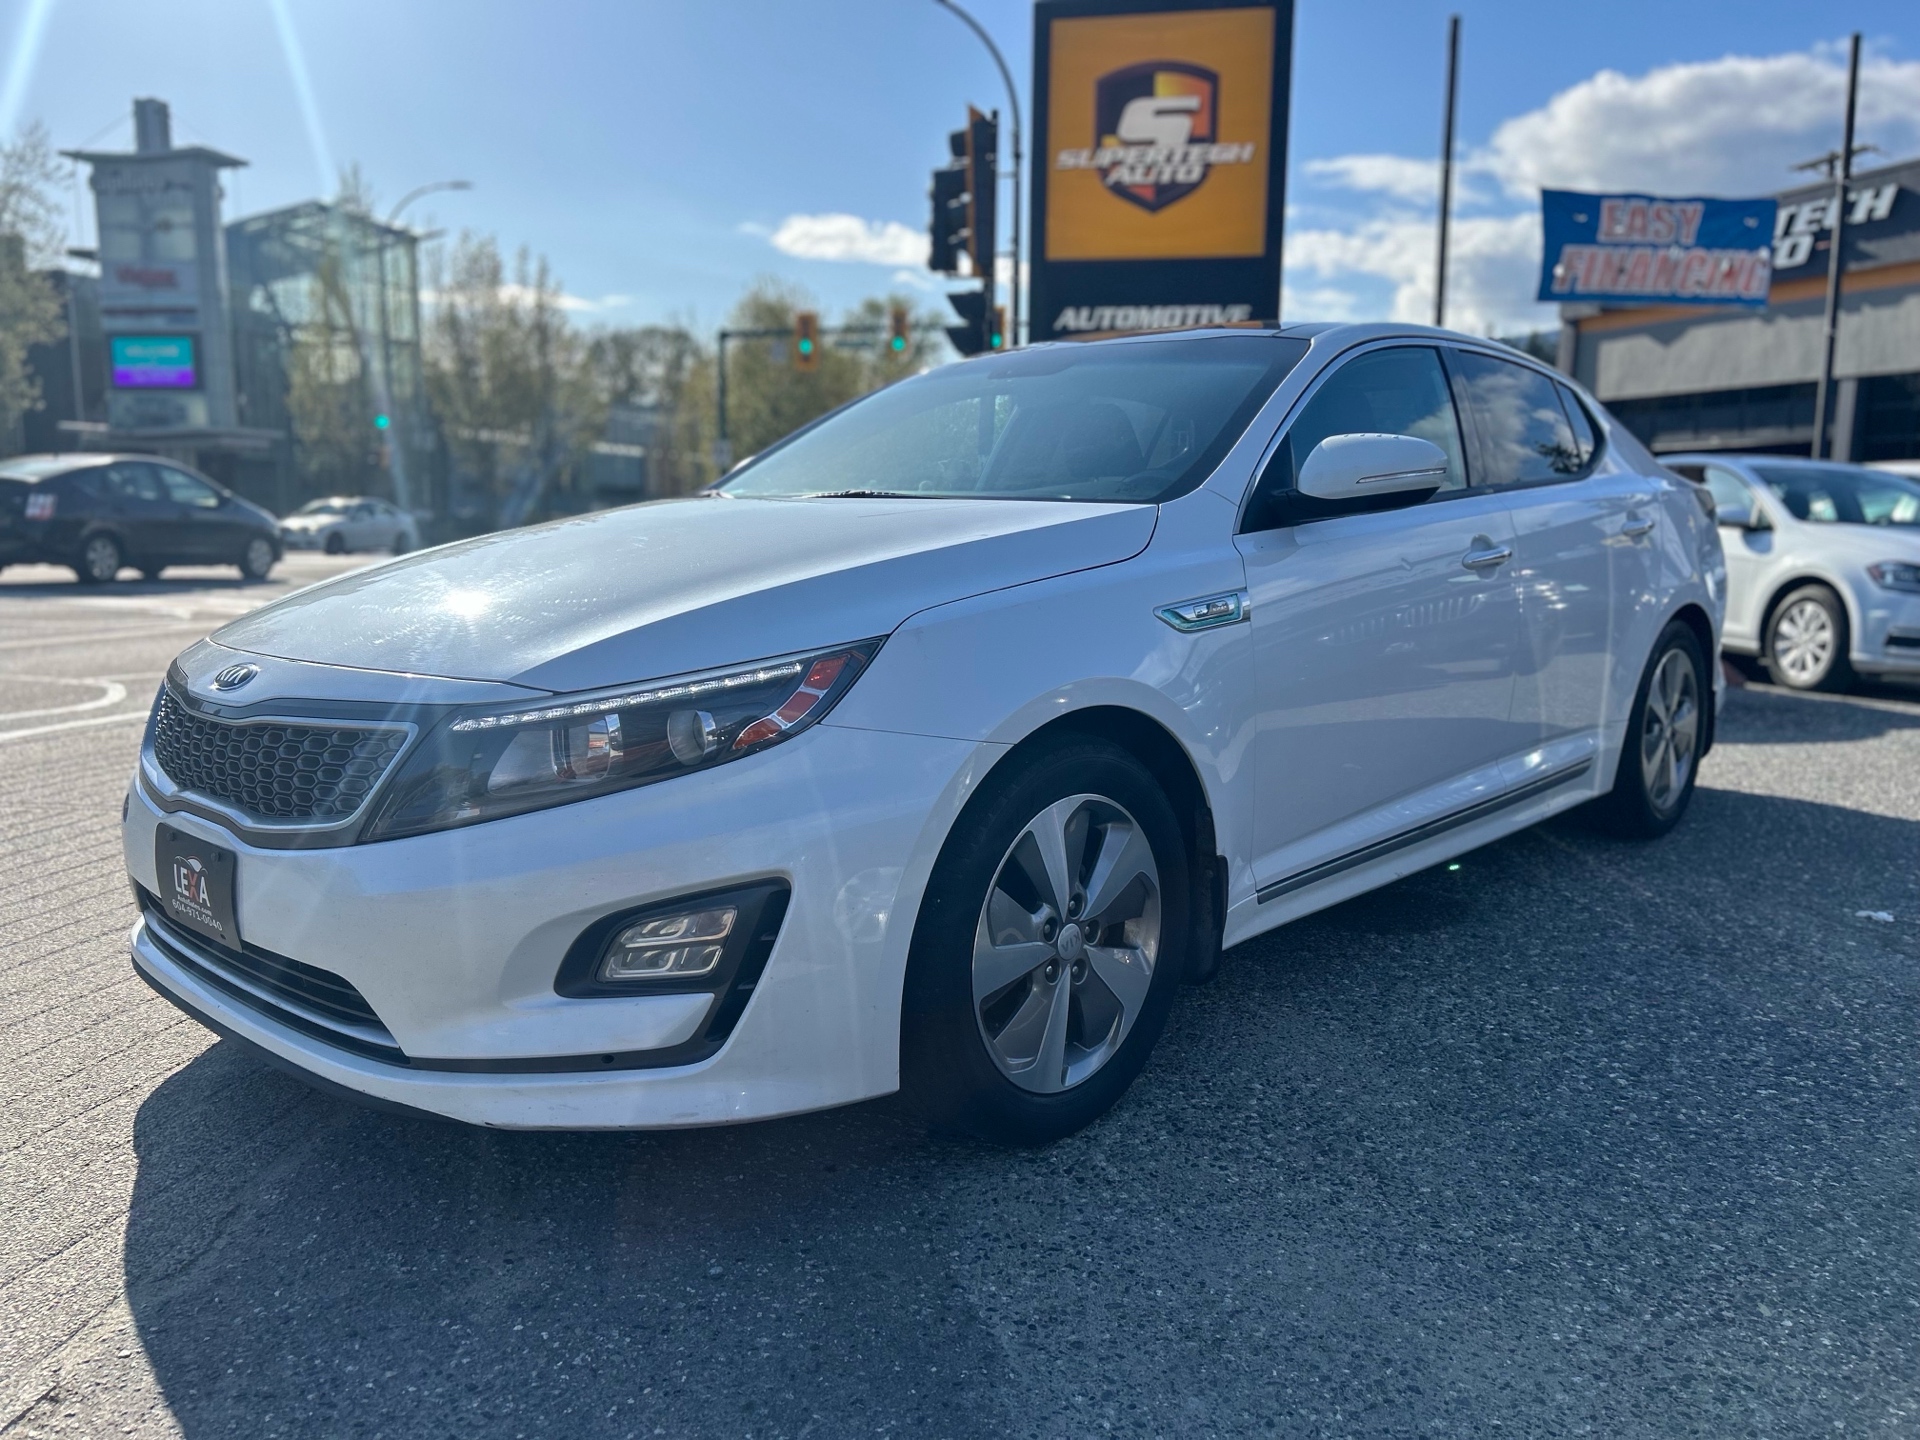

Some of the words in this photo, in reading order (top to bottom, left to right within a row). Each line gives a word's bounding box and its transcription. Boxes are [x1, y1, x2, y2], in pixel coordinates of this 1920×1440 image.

[1056, 143, 1254, 169] SUPERTECH
[1106, 165, 1203, 186] AUTO
[1598, 198, 1704, 244] EASY
[1553, 245, 1771, 296] FINANCING
[1053, 304, 1252, 331] AUTOMOTIVE
[174, 864, 211, 907] LEXA
[1061, 930, 1081, 952] KIA
